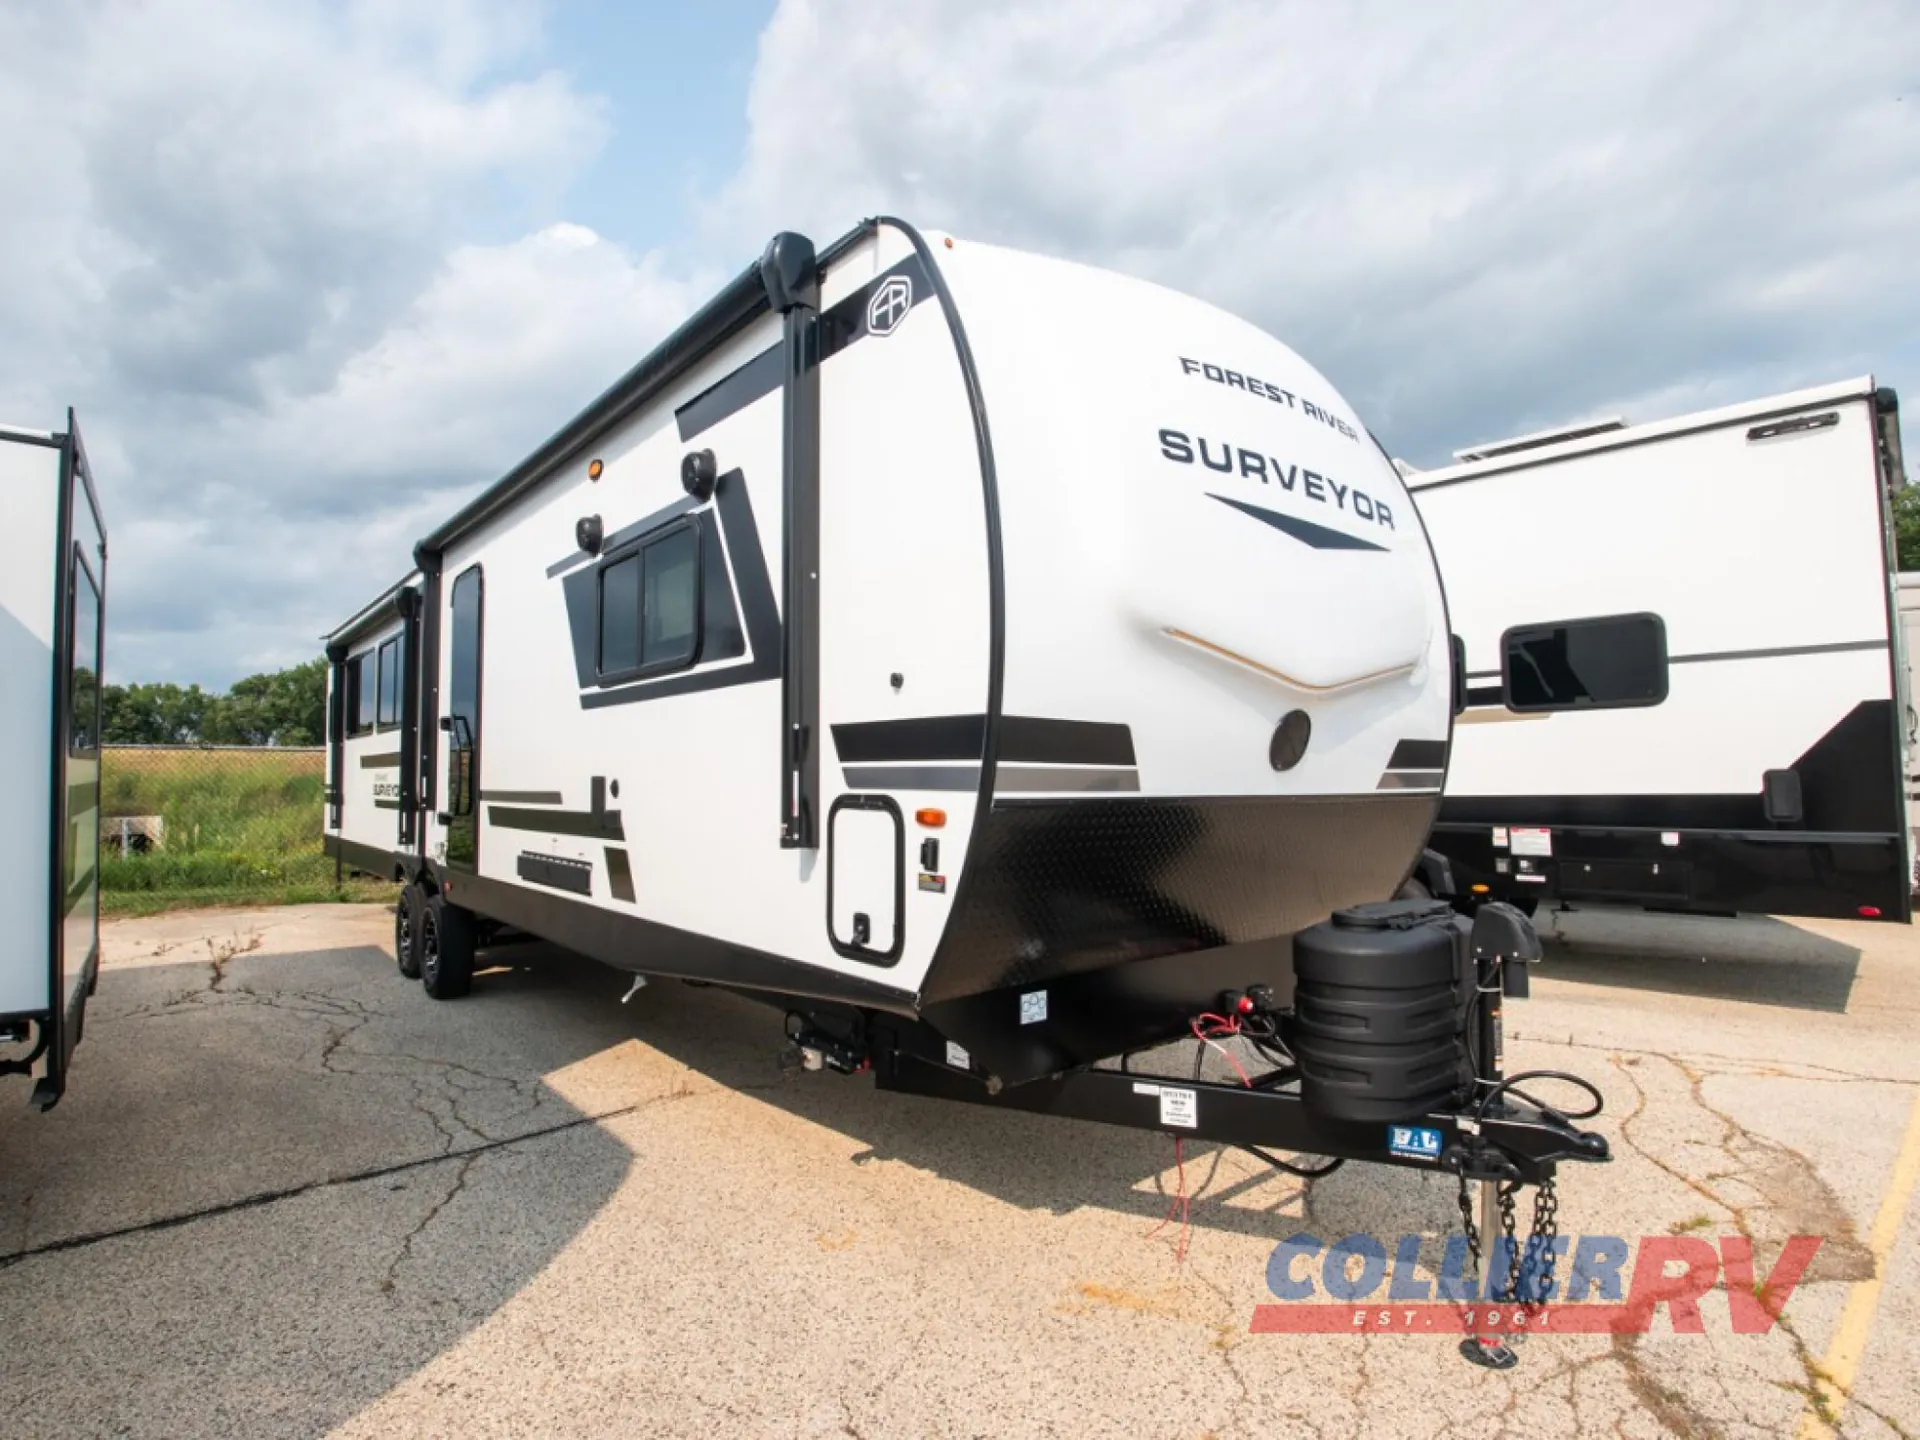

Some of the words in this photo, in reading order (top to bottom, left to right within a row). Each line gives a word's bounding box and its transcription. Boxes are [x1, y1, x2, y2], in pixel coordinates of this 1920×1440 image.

[1179, 356, 1296, 408] FOREST
[1302, 398, 1360, 443] RIVER
[1158, 428, 1396, 531] SURVEYOR
